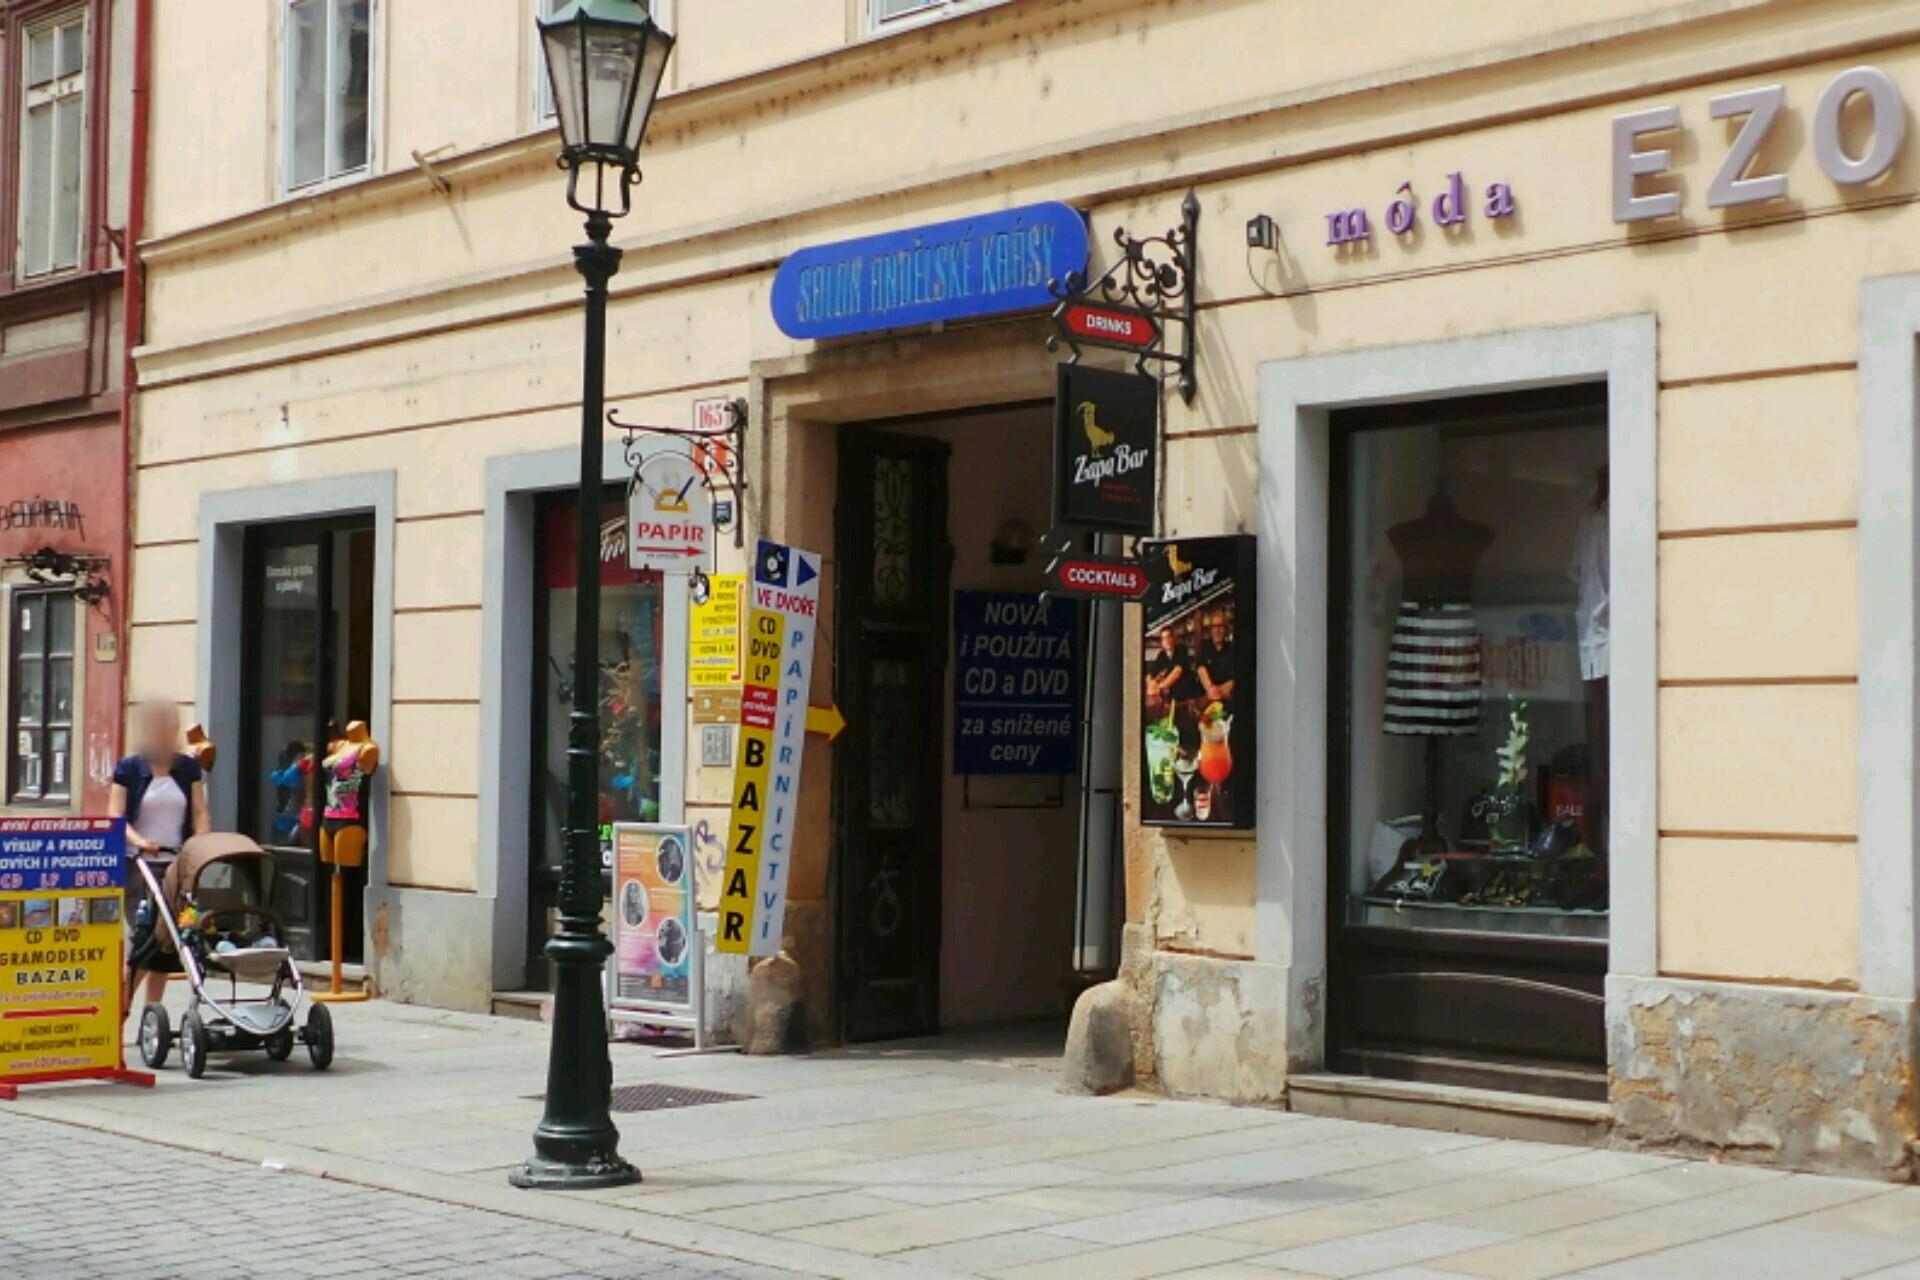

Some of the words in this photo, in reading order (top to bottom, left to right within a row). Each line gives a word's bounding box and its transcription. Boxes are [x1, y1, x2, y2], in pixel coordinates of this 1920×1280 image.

[1611, 64, 1904, 223] EZO
[1086, 314, 1132, 335] DRINKS
[1073, 454, 1115, 487] Zapa
[1114, 443, 1149, 474] Bar
[637, 520, 704, 541] PAPÍR
[1067, 568, 1137, 588] COCKTAILS
[1191, 567, 1219, 591] Bar
[757, 588, 772, 608] VE
[776, 593, 815, 617] DVOŘE
[984, 598, 1050, 625] NOVÁ
[758, 616, 776, 635] CD
[750, 638, 780, 659] DVD
[973, 631, 1072, 658] POUŽITÁ
[754, 662, 772, 683] LP
[965, 667, 997, 694] CD
[1002, 673, 1016, 695] a
[1021, 668, 1070, 695] DVD
[960, 719, 985, 736] za
[991, 713, 1072, 736] snížené
[989, 743, 1042, 765] ceny
[3, 837, 43, 853] VÝKUP
[46, 840, 55, 852] A
[59, 838, 106, 851] PRODEJ
[723, 736, 766, 943] BAZAR
[0, 854, 40, 870] OVÝCH
[25, 931, 43, 944] CD
[54, 928, 81, 942] DVD
[0, 948, 106, 966] GRAMODESKY
[16, 967, 87, 985] BAZAR
